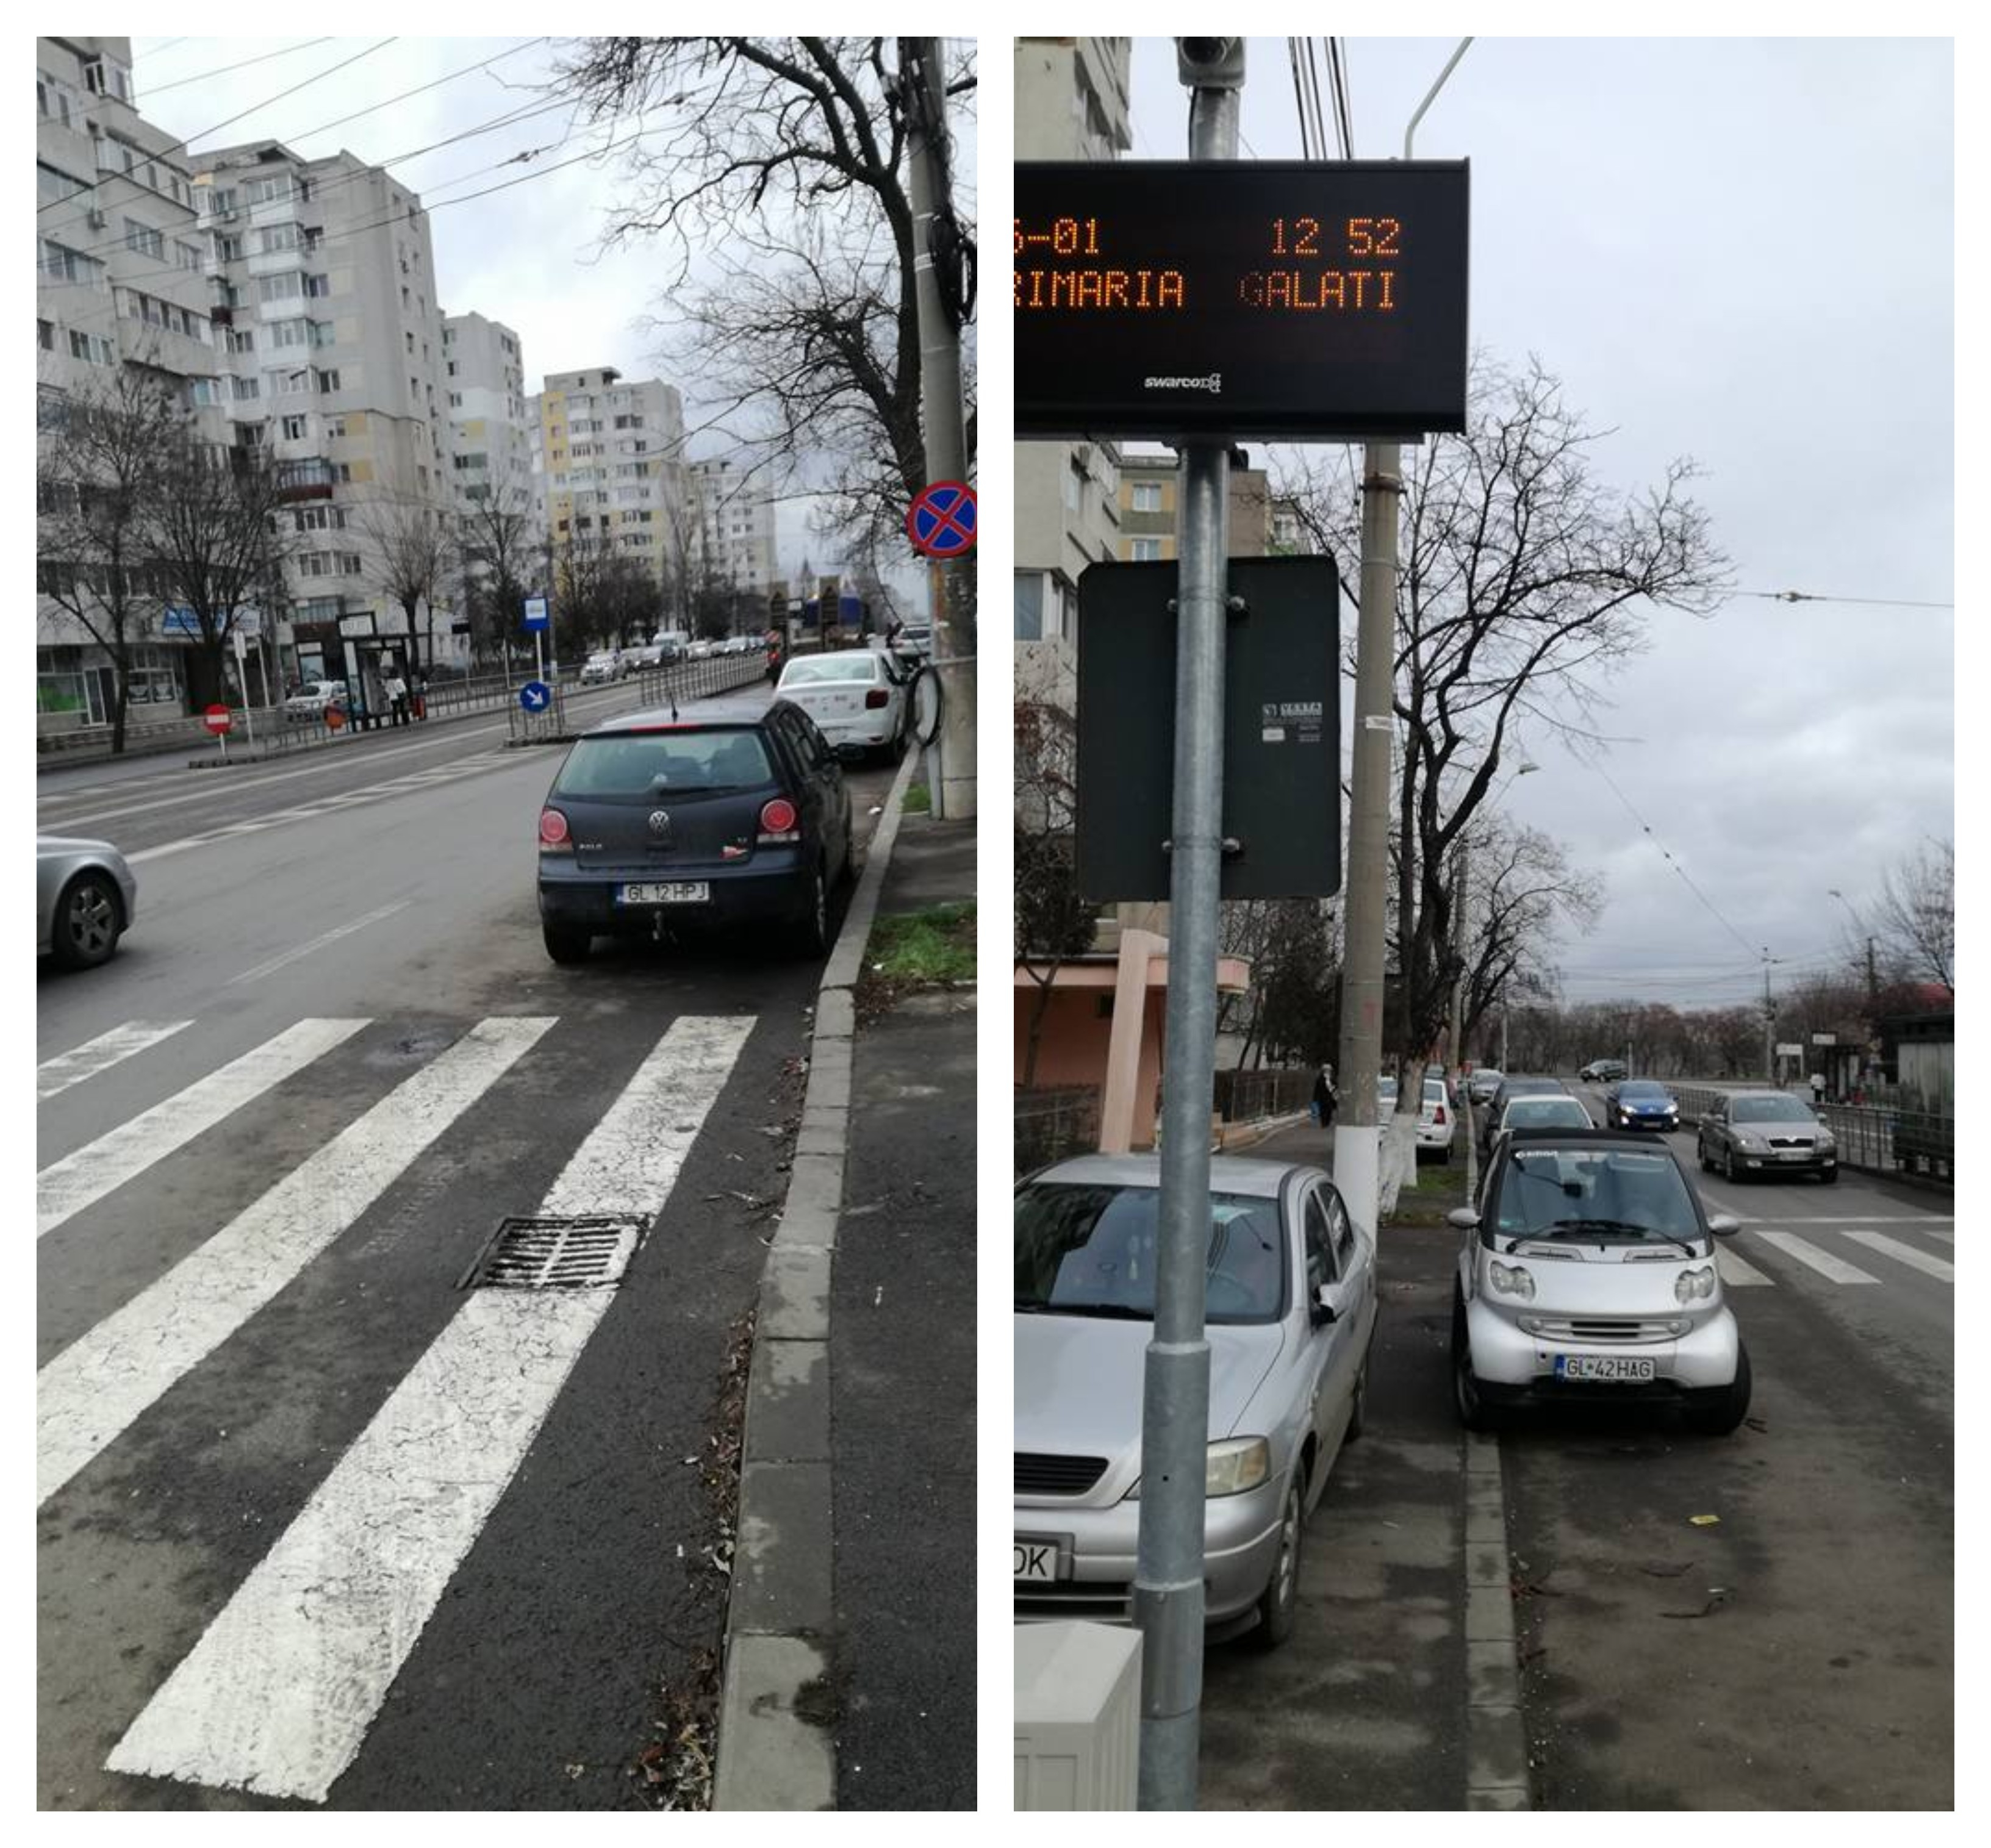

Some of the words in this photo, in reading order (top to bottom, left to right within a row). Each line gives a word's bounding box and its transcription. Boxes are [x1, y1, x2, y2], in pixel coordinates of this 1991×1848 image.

[1273, 218, 1318, 254] 12
[1349, 218, 1399, 254] 52
[1240, 271, 1393, 307] GALATI
[628, 885, 648, 901] GL
